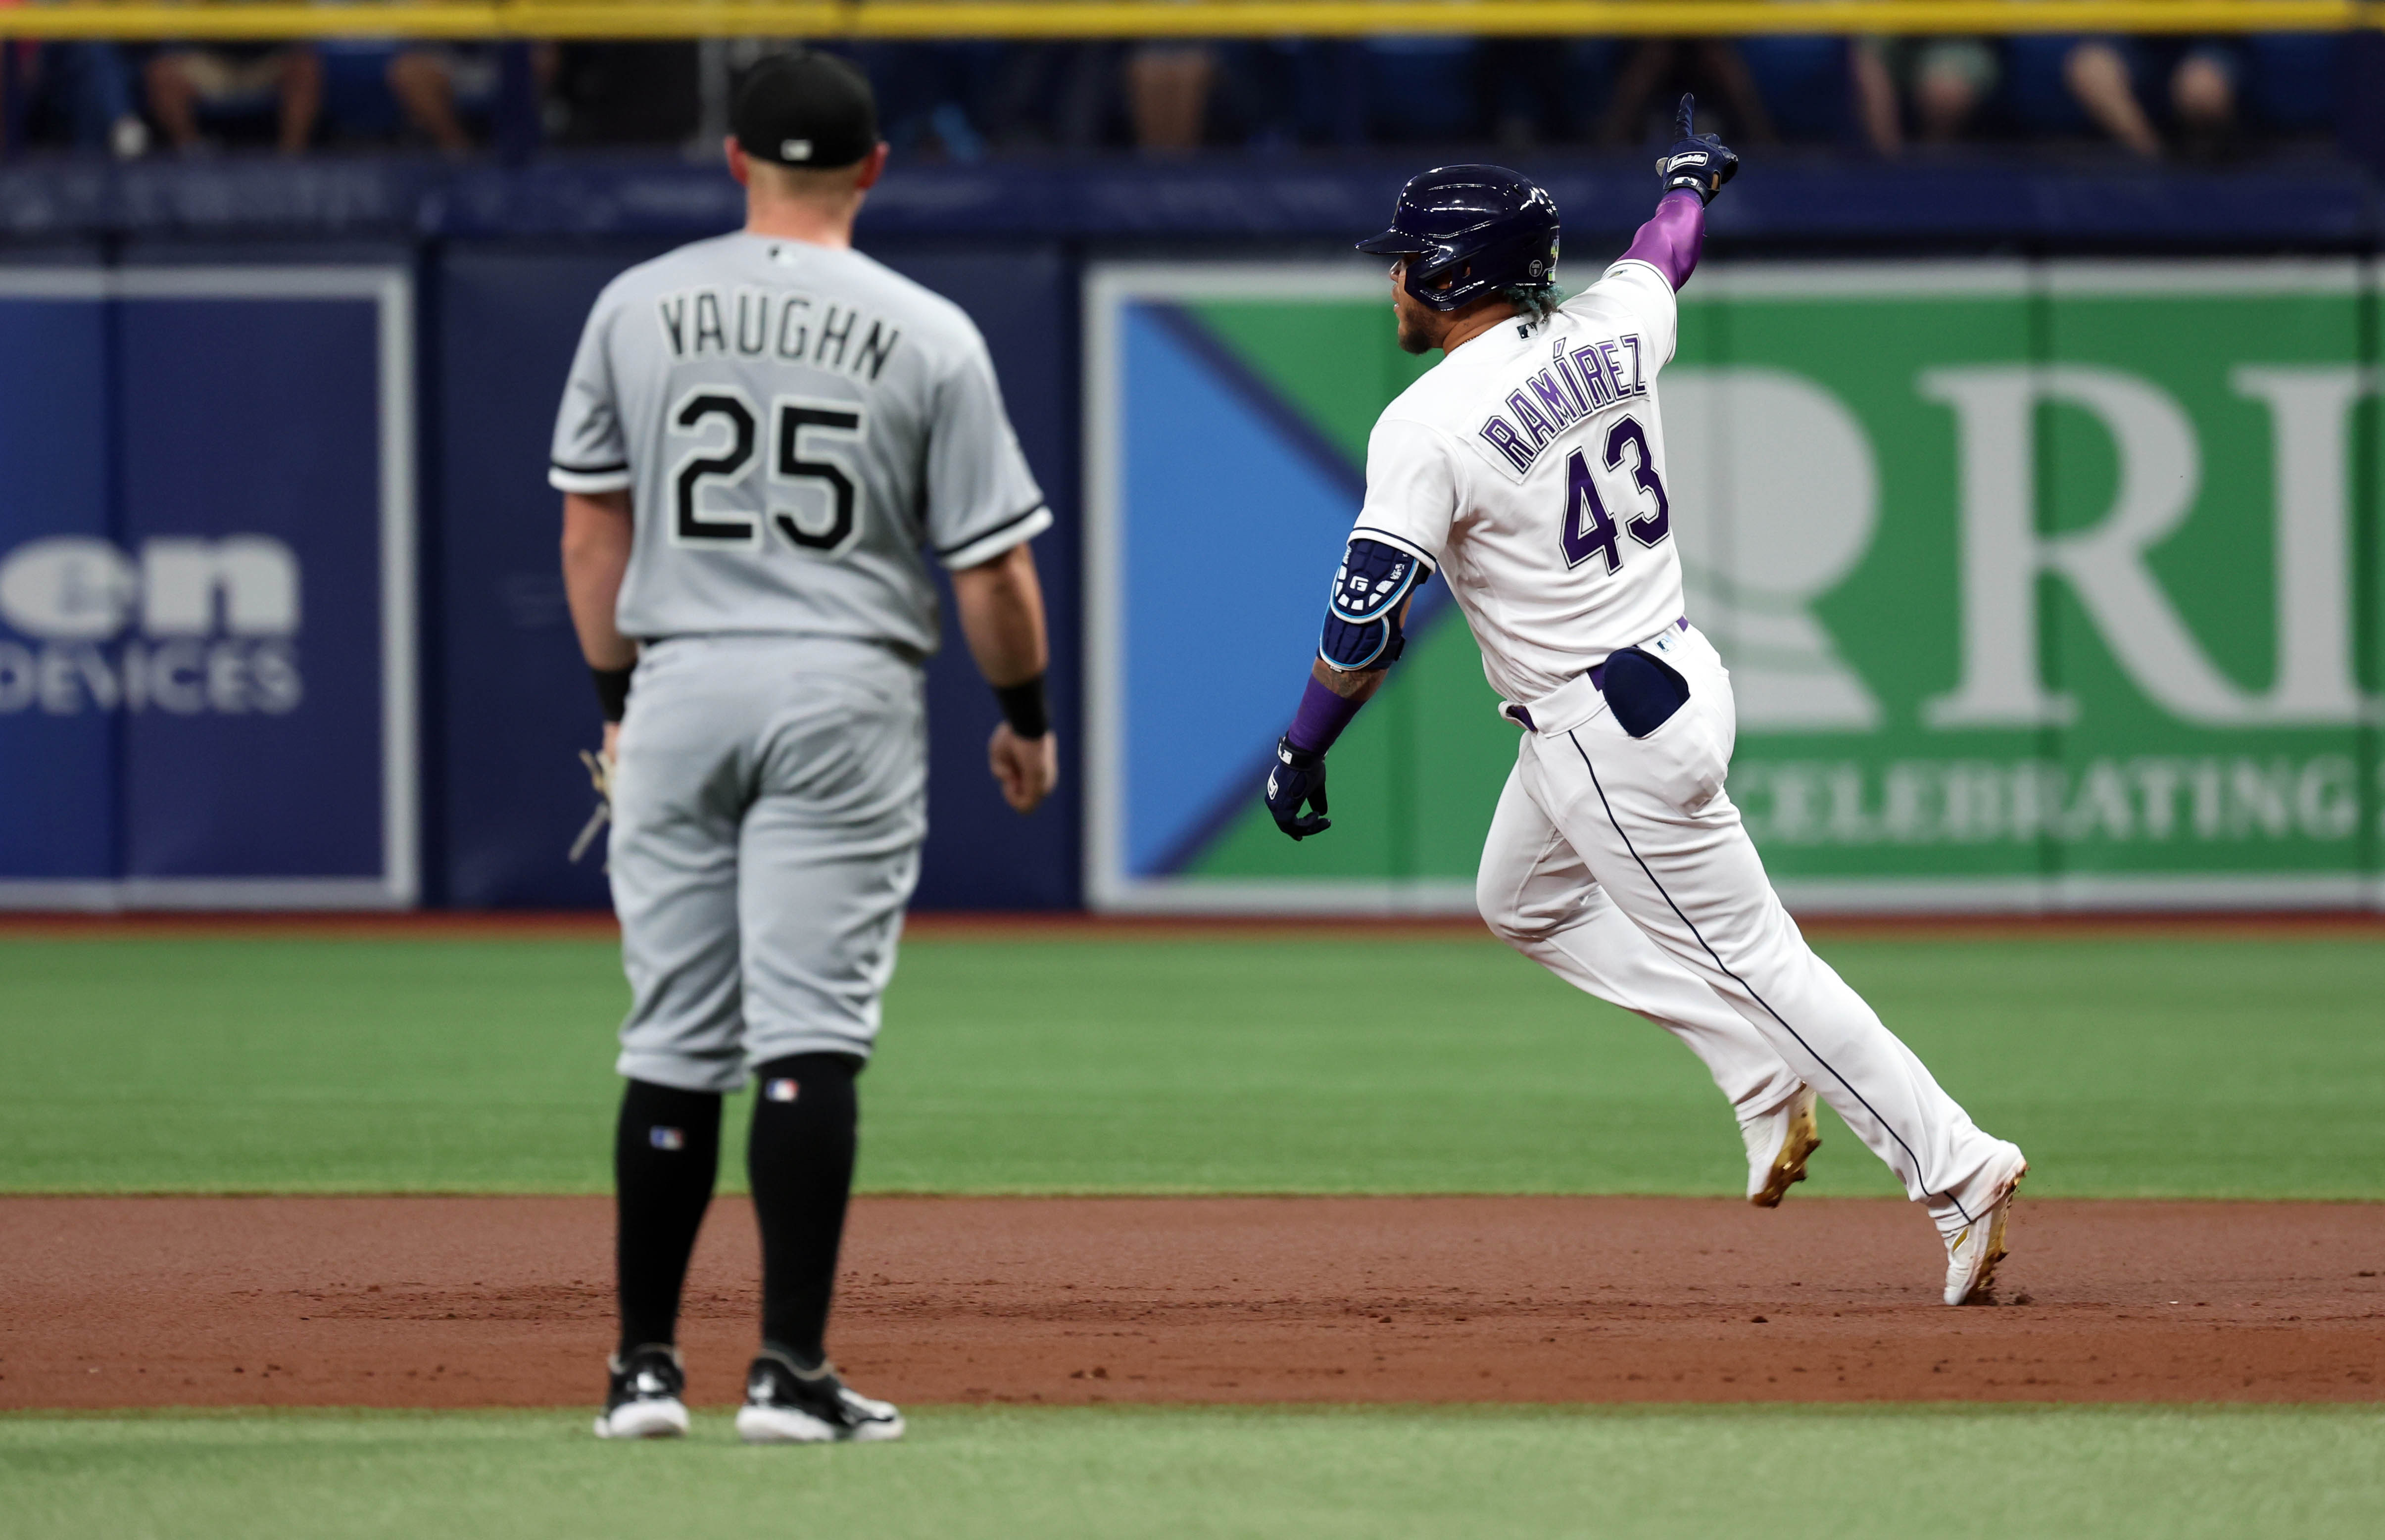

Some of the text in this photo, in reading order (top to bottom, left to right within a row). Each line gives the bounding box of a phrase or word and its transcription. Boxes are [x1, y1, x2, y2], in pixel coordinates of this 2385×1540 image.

[659, 289, 902, 383] VAUGHN
[1479, 334, 1648, 475] RAMÍREZ
[672, 388, 865, 555] 25
[1560, 414, 1670, 576] 43
